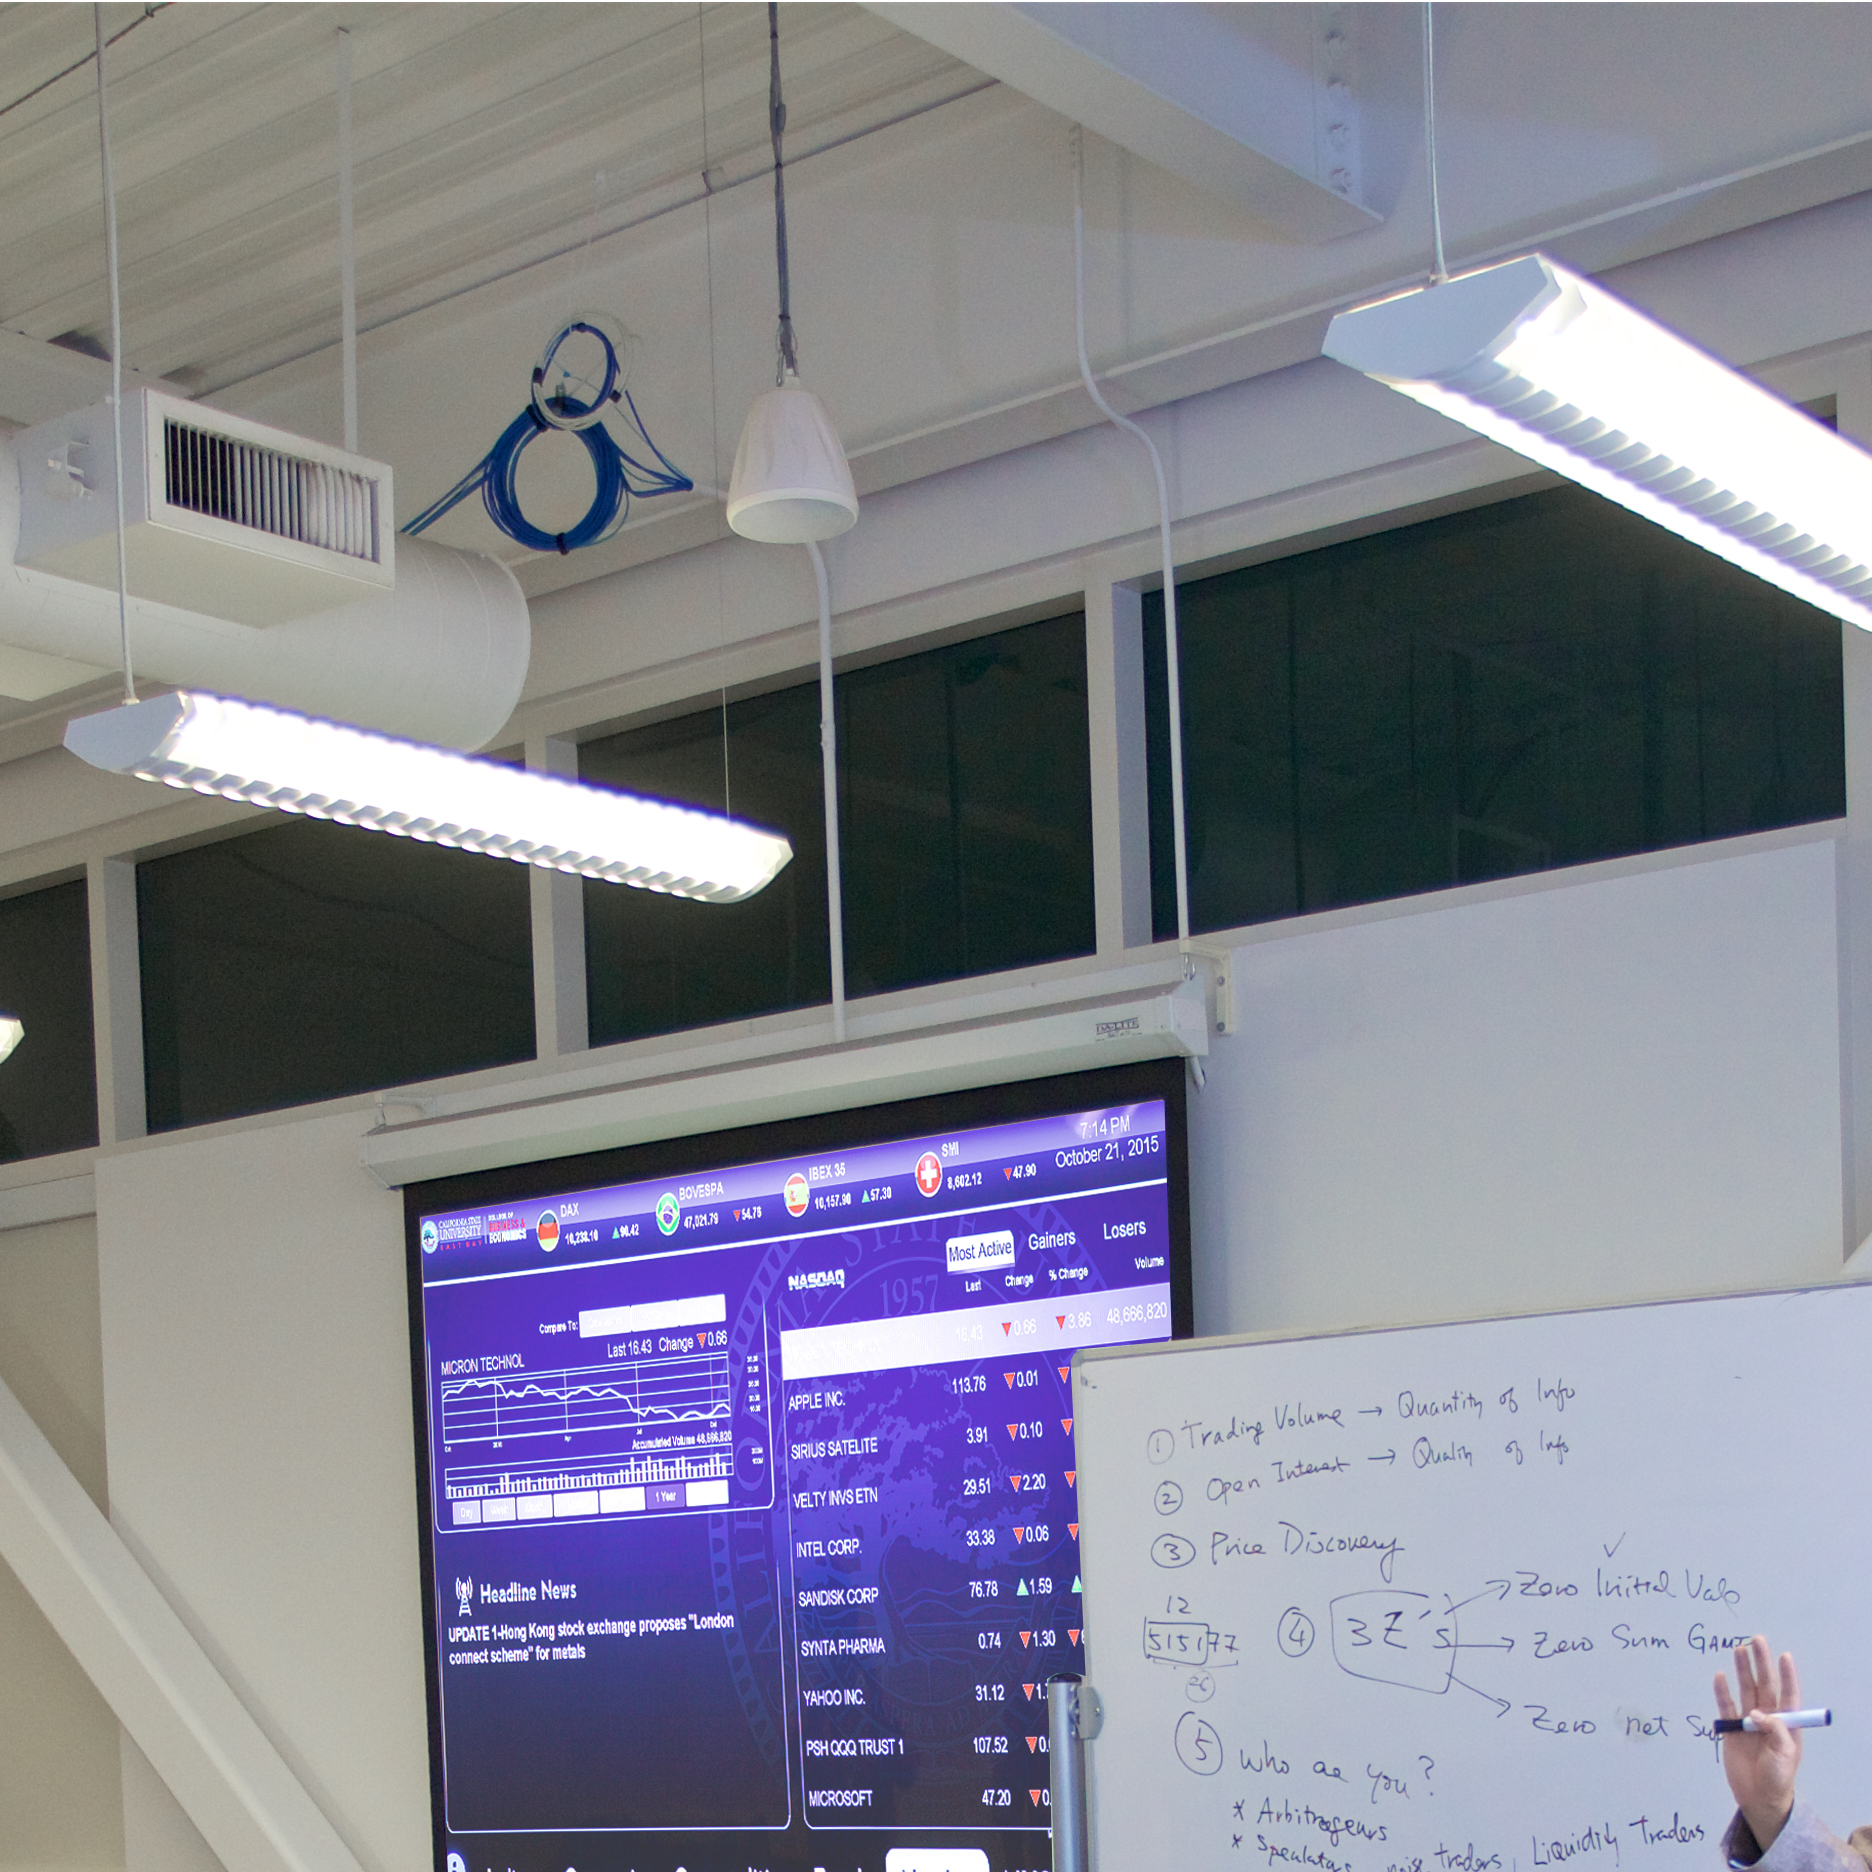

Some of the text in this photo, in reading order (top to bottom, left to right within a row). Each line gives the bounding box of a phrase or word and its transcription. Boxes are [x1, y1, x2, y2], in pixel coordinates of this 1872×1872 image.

[1080, 1115, 1130, 1139] 7:14 PM
[941, 1142, 959, 1157] SMI
[1055, 1135, 1159, 1168] October 21, 2015
[809, 1162, 846, 1181] IBEX 35
[1013, 1164, 1036, 1180] 47.90
[947, 1172, 982, 1191] 8,602.12
[679, 1186, 724, 1201] BOVESPA
[814, 1192, 851, 1211] 10,157.90
[871, 1187, 891, 1201] 57.30
[560, 1202, 579, 1217] DAX
[488, 1219, 519, 1232] BUSINESS
[620, 1223, 639, 1238] 90.42
[684, 1212, 718, 1230] 47,021.79
[439, 1225, 482, 1240] UNIVERSITY
[1103, 1221, 1147, 1241] Losers
[440, 1240, 482, 1251] EAST BAY
[1028, 1231, 1076, 1251] Gainers
[948, 1240, 1013, 1262] Most Active
[1135, 1254, 1165, 1270] Volume
[788, 1269, 845, 1292] NASDAQ
[1005, 1273, 1034, 1289] Change
[1058, 1266, 1088, 1281] Change
[965, 1279, 982, 1292] Last
[1068, 1312, 1092, 1330] 3.86
[1106, 1302, 1168, 1325] 48,666,820
[539, 1320, 579, 1337] Compare To:
[608, 1340, 653, 1359] Last 16.43
[659, 1336, 694, 1355] Change
[441, 1352, 525, 1377] MICRON TECHNOL
[951, 1376, 986, 1395] 113.76
[1016, 1368, 1039, 1388] 0.01
[788, 1389, 846, 1411] APPLE INC.
[1182, 1419, 1264, 1449] Trading
[1275, 1402, 1345, 1431] Volume
[1500, 1387, 1519, 1414] of
[1537, 1378, 1576, 1412] Info
[966, 1426, 989, 1444] 3.91
[1020, 1420, 1043, 1439] 0.10
[672, 1432, 696, 1448] Volume
[791, 1437, 878, 1459] SIRIUS SATELITE
[1207, 1477, 1260, 1505] Open
[1271, 1457, 1351, 1484] Interest
[1505, 1439, 1523, 1465] of
[963, 1477, 991, 1496] 29.51
[1023, 1473, 1046, 1491] 2.20
[661, 1490, 676, 1503] Year
[793, 1486, 878, 1509] VELTY INVS ETN
[966, 1528, 996, 1547] 33.38
[1026, 1524, 1049, 1543] 0.06
[796, 1538, 862, 1558] INTEL CORP.
[1211, 1521, 1405, 1583] Price Discovery
[481, 1579, 577, 1605] Headline News
[969, 1580, 998, 1598] 76.78
[1029, 1577, 1053, 1595] 1.59
[1515, 1571, 1578, 1597] Zero
[798, 1586, 878, 1607] SANDISK CORP
[448, 1611, 734, 1644] UPDATE 1-Hong Kong stock exchange proposes "London
[1347, 1617, 1372, 1647] 3
[801, 1637, 885, 1657] SYNTA PHARMA
[978, 1631, 1001, 1649] 0.74
[1033, 1629, 1056, 1648] 1.30
[1533, 1631, 1594, 1659] Zero
[1612, 1624, 1670, 1650] Sum
[449, 1642, 586, 1665] connect scheme" for metals
[803, 1687, 866, 1706] YAHOO INC.
[975, 1683, 1005, 1702] 31.12
[1523, 1705, 1597, 1734] Zero
[807, 1737, 904, 1757] PSH QQQ TRUST 1
[973, 1735, 1008, 1754] 107.52
[1240, 1740, 1290, 1775] Who
[809, 1789, 873, 1807] MICROSOFT
[981, 1787, 1011, 1806] 47.20
